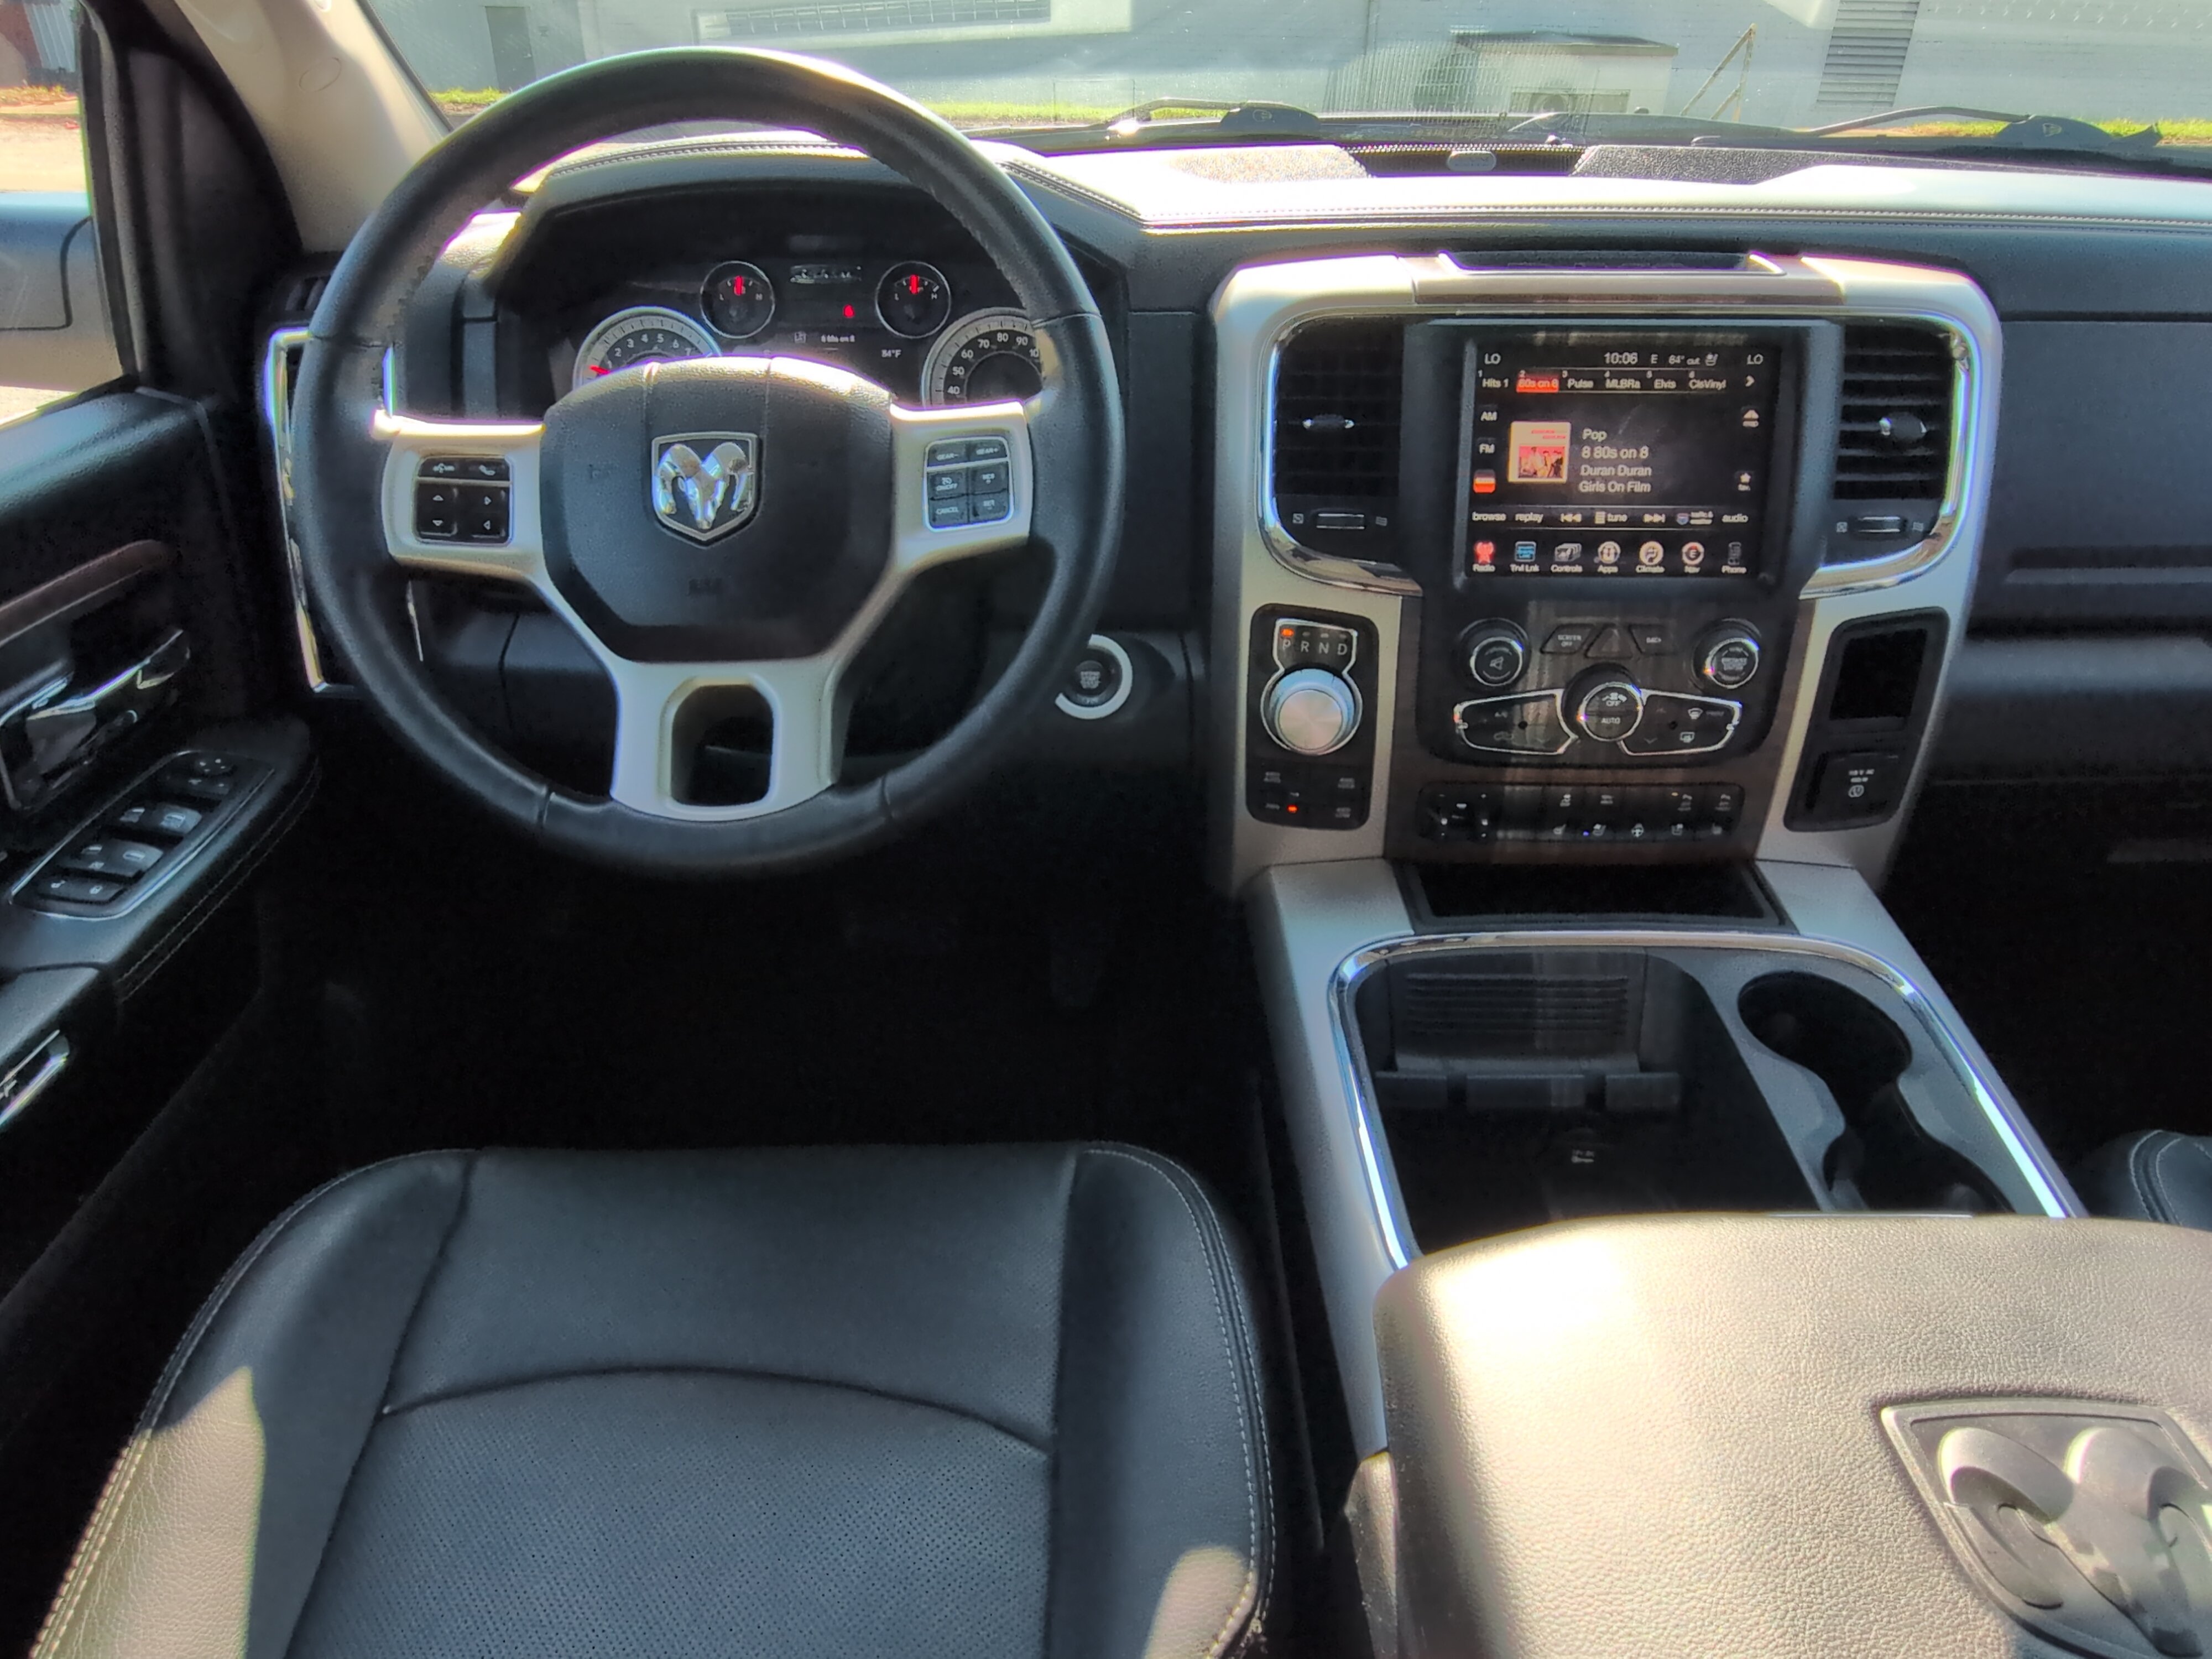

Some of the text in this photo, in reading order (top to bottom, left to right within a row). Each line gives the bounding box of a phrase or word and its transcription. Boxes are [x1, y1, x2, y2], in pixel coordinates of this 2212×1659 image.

[627, 338, 634, 347] 3
[641, 333, 649, 343] 4
[657, 333, 664, 343] 5
[997, 333, 1009, 342] 80
[1016, 336, 1028, 346] 90
[672, 338, 680, 348] 6
[977, 339, 990, 348] 70
[614, 347, 622, 357] 2
[961, 349, 973, 358] 60
[1484, 353, 1501, 364] LO
[1604, 352, 1638, 364] 10:06
[1651, 354, 1658, 364] E
[1746, 354, 1764, 364] LO
[952, 366, 964, 376] 50
[1483, 378, 1509, 388] Hits 1
[1567, 379, 1594, 388] Pulse
[1654, 379, 1676, 389] Elvis
[947, 386, 960, 395] 40
[1481, 412, 1497, 421] AM
[1582, 428, 1607, 442] Pop
[1479, 444, 1495, 453] FM
[1582, 446, 1649, 458] 8 80s on 8
[1580, 465, 1652, 476] Duran Duran
[1579, 481, 1651, 493] Girls On Film
[1472, 511, 1506, 521] browse
[1515, 512, 1543, 523] replay
[1607, 513, 1627, 522] tune
[1721, 514, 1749, 523] audio
[1551, 564, 1583, 573] Controls
[1598, 565, 1618, 573] Apps
[1636, 565, 1665, 573] Climate
[1721, 565, 1747, 574] Phone
[1282, 639, 1348, 656] P R N D
